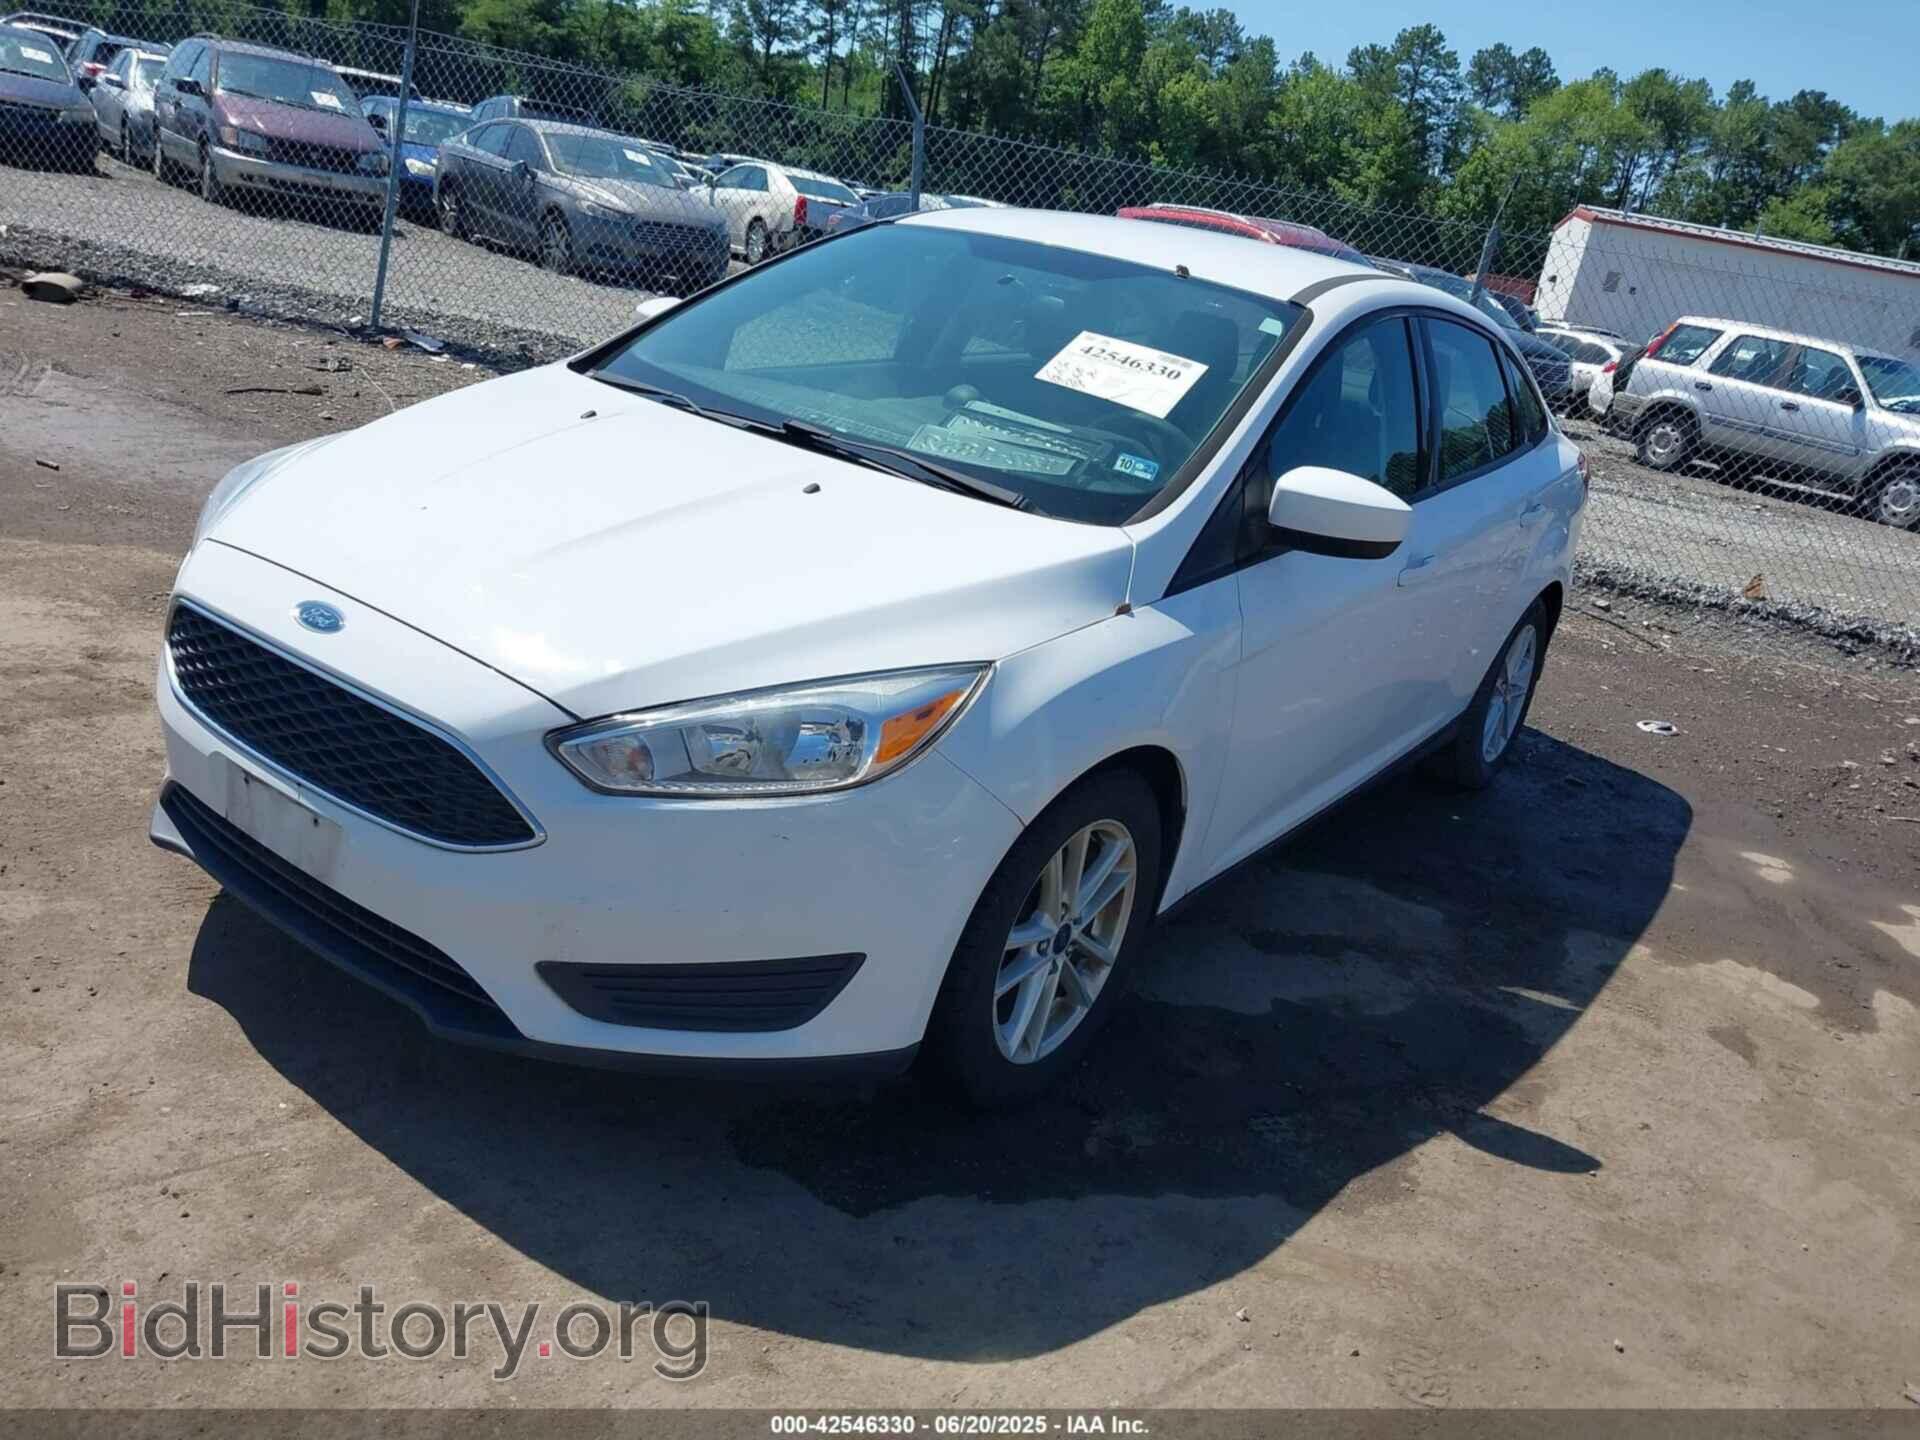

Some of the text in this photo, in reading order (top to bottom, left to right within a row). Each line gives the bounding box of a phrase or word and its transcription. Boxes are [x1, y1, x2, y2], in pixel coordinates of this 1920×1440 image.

[1080, 345, 1182, 381] 42546330
[1119, 458, 1133, 471] 10
[302, 607, 337, 628] Ford
